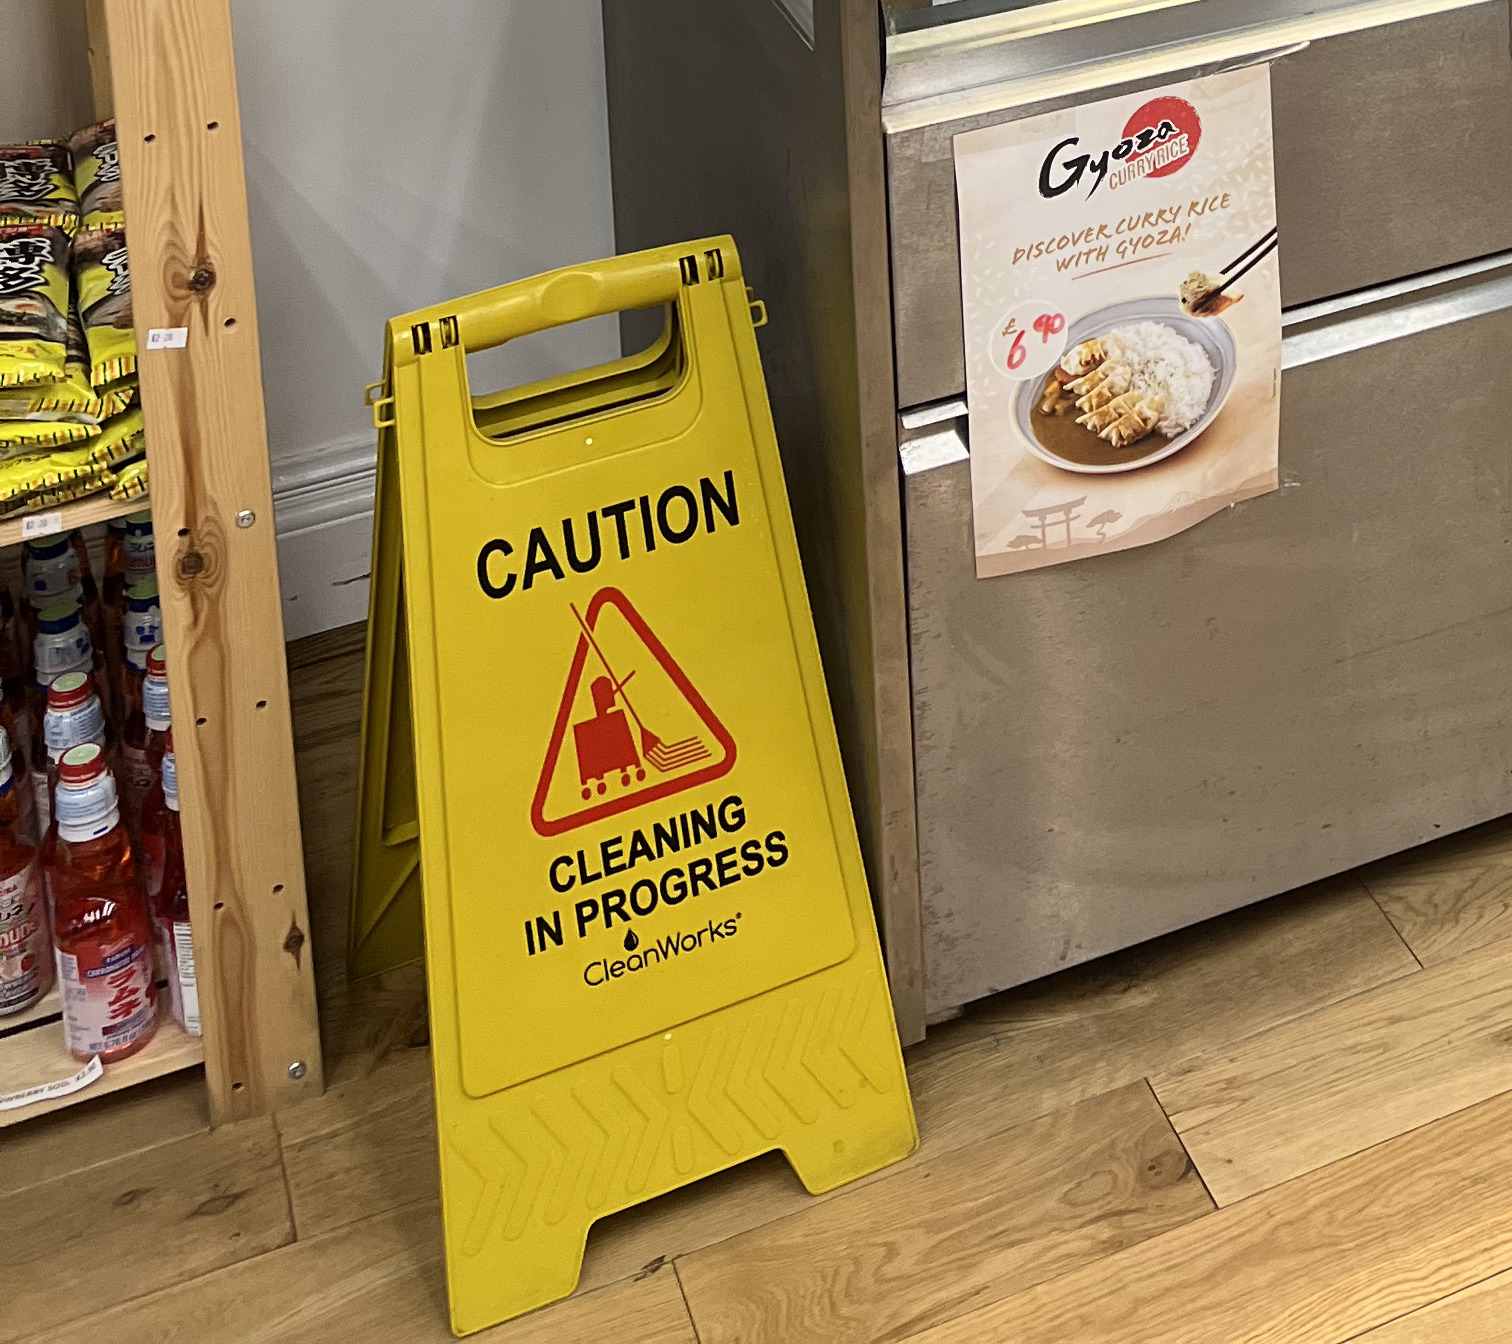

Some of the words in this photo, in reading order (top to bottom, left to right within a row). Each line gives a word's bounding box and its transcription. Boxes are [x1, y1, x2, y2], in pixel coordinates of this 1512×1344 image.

[1038, 120, 1179, 202] Gyoza
[1109, 154, 1157, 191] CURRY
[1156, 134, 1190, 169] RICE
[1012, 223, 1113, 266] DISCOVER
[1114, 204, 1183, 235] CURRY
[1188, 192, 1231, 218] RICE
[1055, 244, 1110, 273] WITH
[1115, 223, 1192, 260] GYOZA!
[476, 469, 741, 600] CAUTION
[549, 794, 747, 894] CLEANING
[524, 910, 565, 957] IN
[577, 829, 789, 940] PROGRESS
